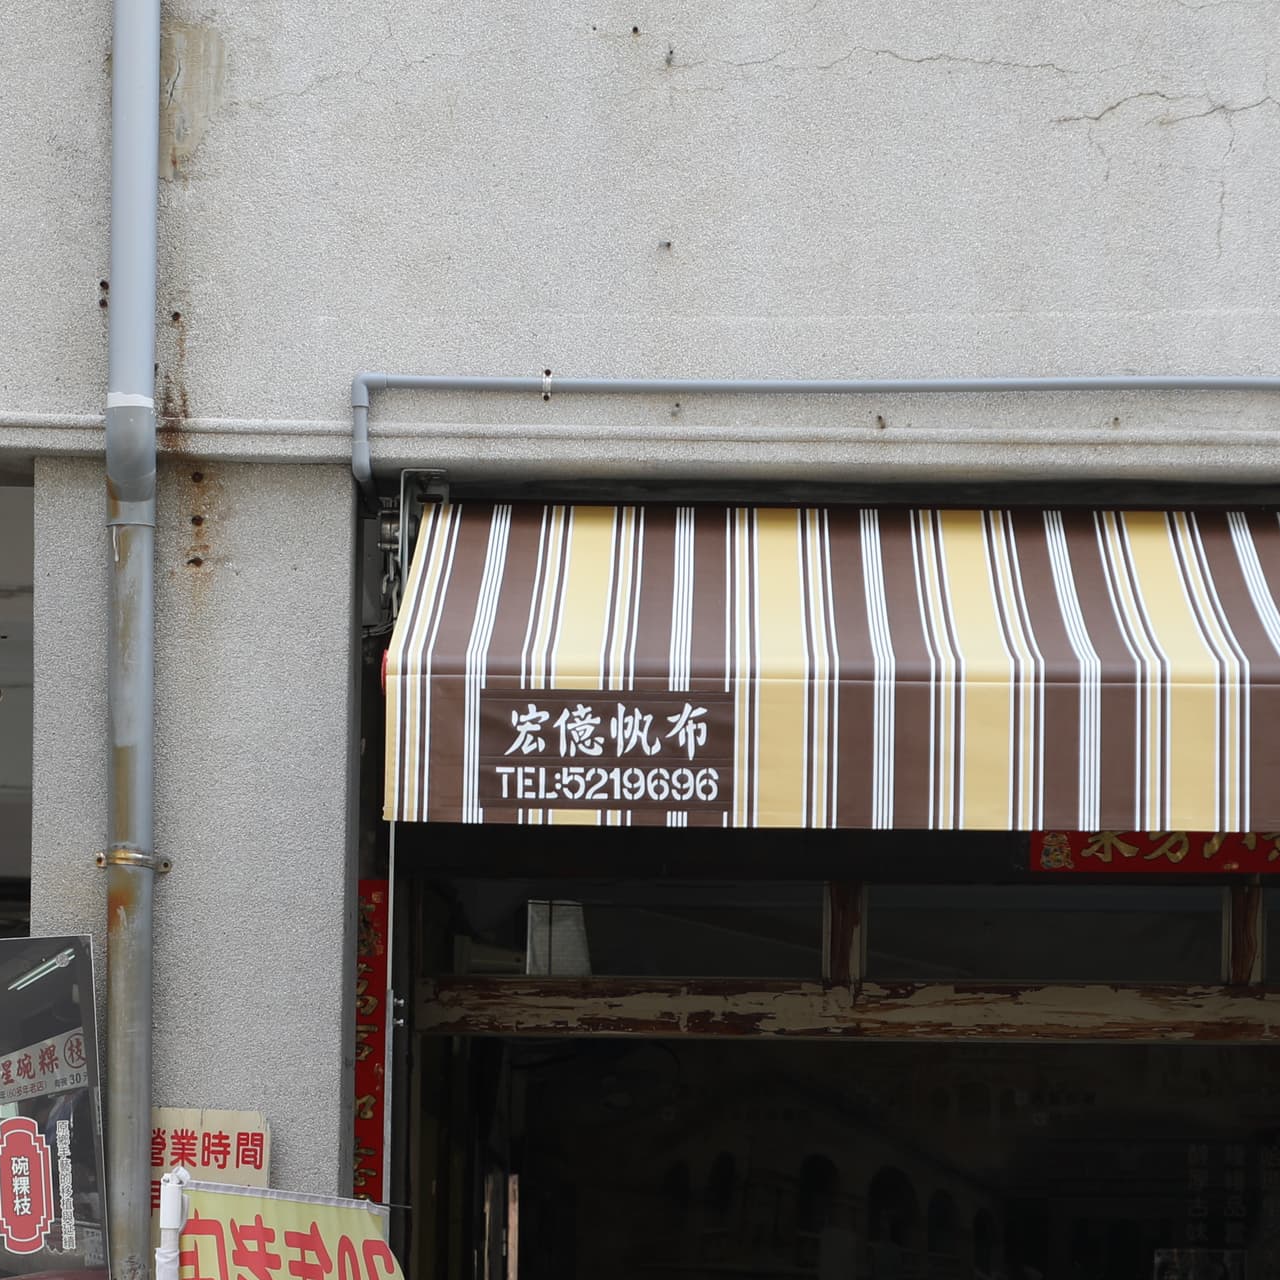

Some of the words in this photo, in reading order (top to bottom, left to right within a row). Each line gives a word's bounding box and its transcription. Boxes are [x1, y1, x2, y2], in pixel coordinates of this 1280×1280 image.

[504, 702, 709, 760] 宏億帆布
[495, 766, 719, 801] TEL:5219696
[11, 1156, 32, 1216] 碗粿枝
